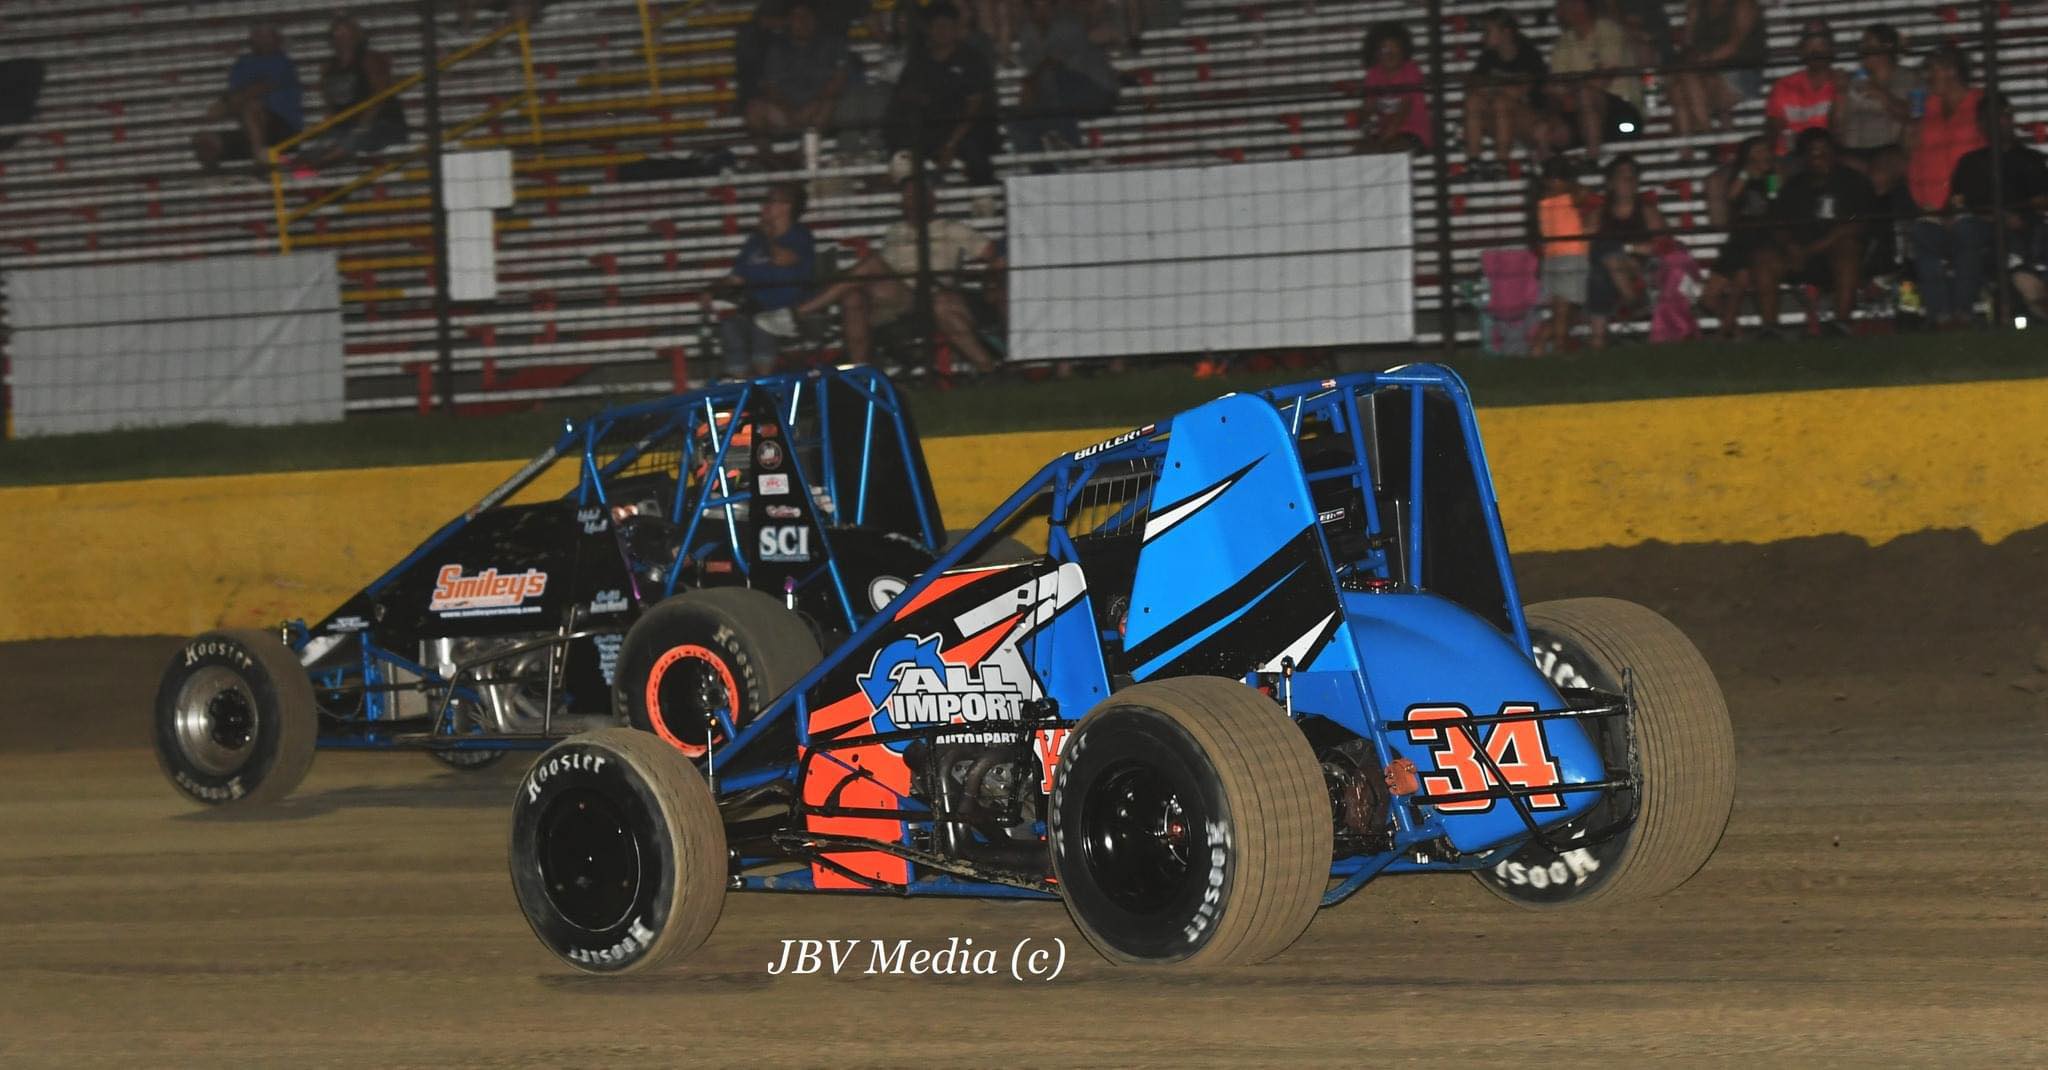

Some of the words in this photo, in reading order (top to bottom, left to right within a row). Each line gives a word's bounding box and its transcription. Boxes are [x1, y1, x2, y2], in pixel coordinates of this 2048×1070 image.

[1073, 428, 1139, 461] BUTLER
[759, 526, 809, 556] SCI
[432, 564, 547, 605] Smiley's
[896, 664, 1018, 694] ALL
[892, 692, 1024, 723] IMPORT
[1403, 702, 1568, 814] 34
